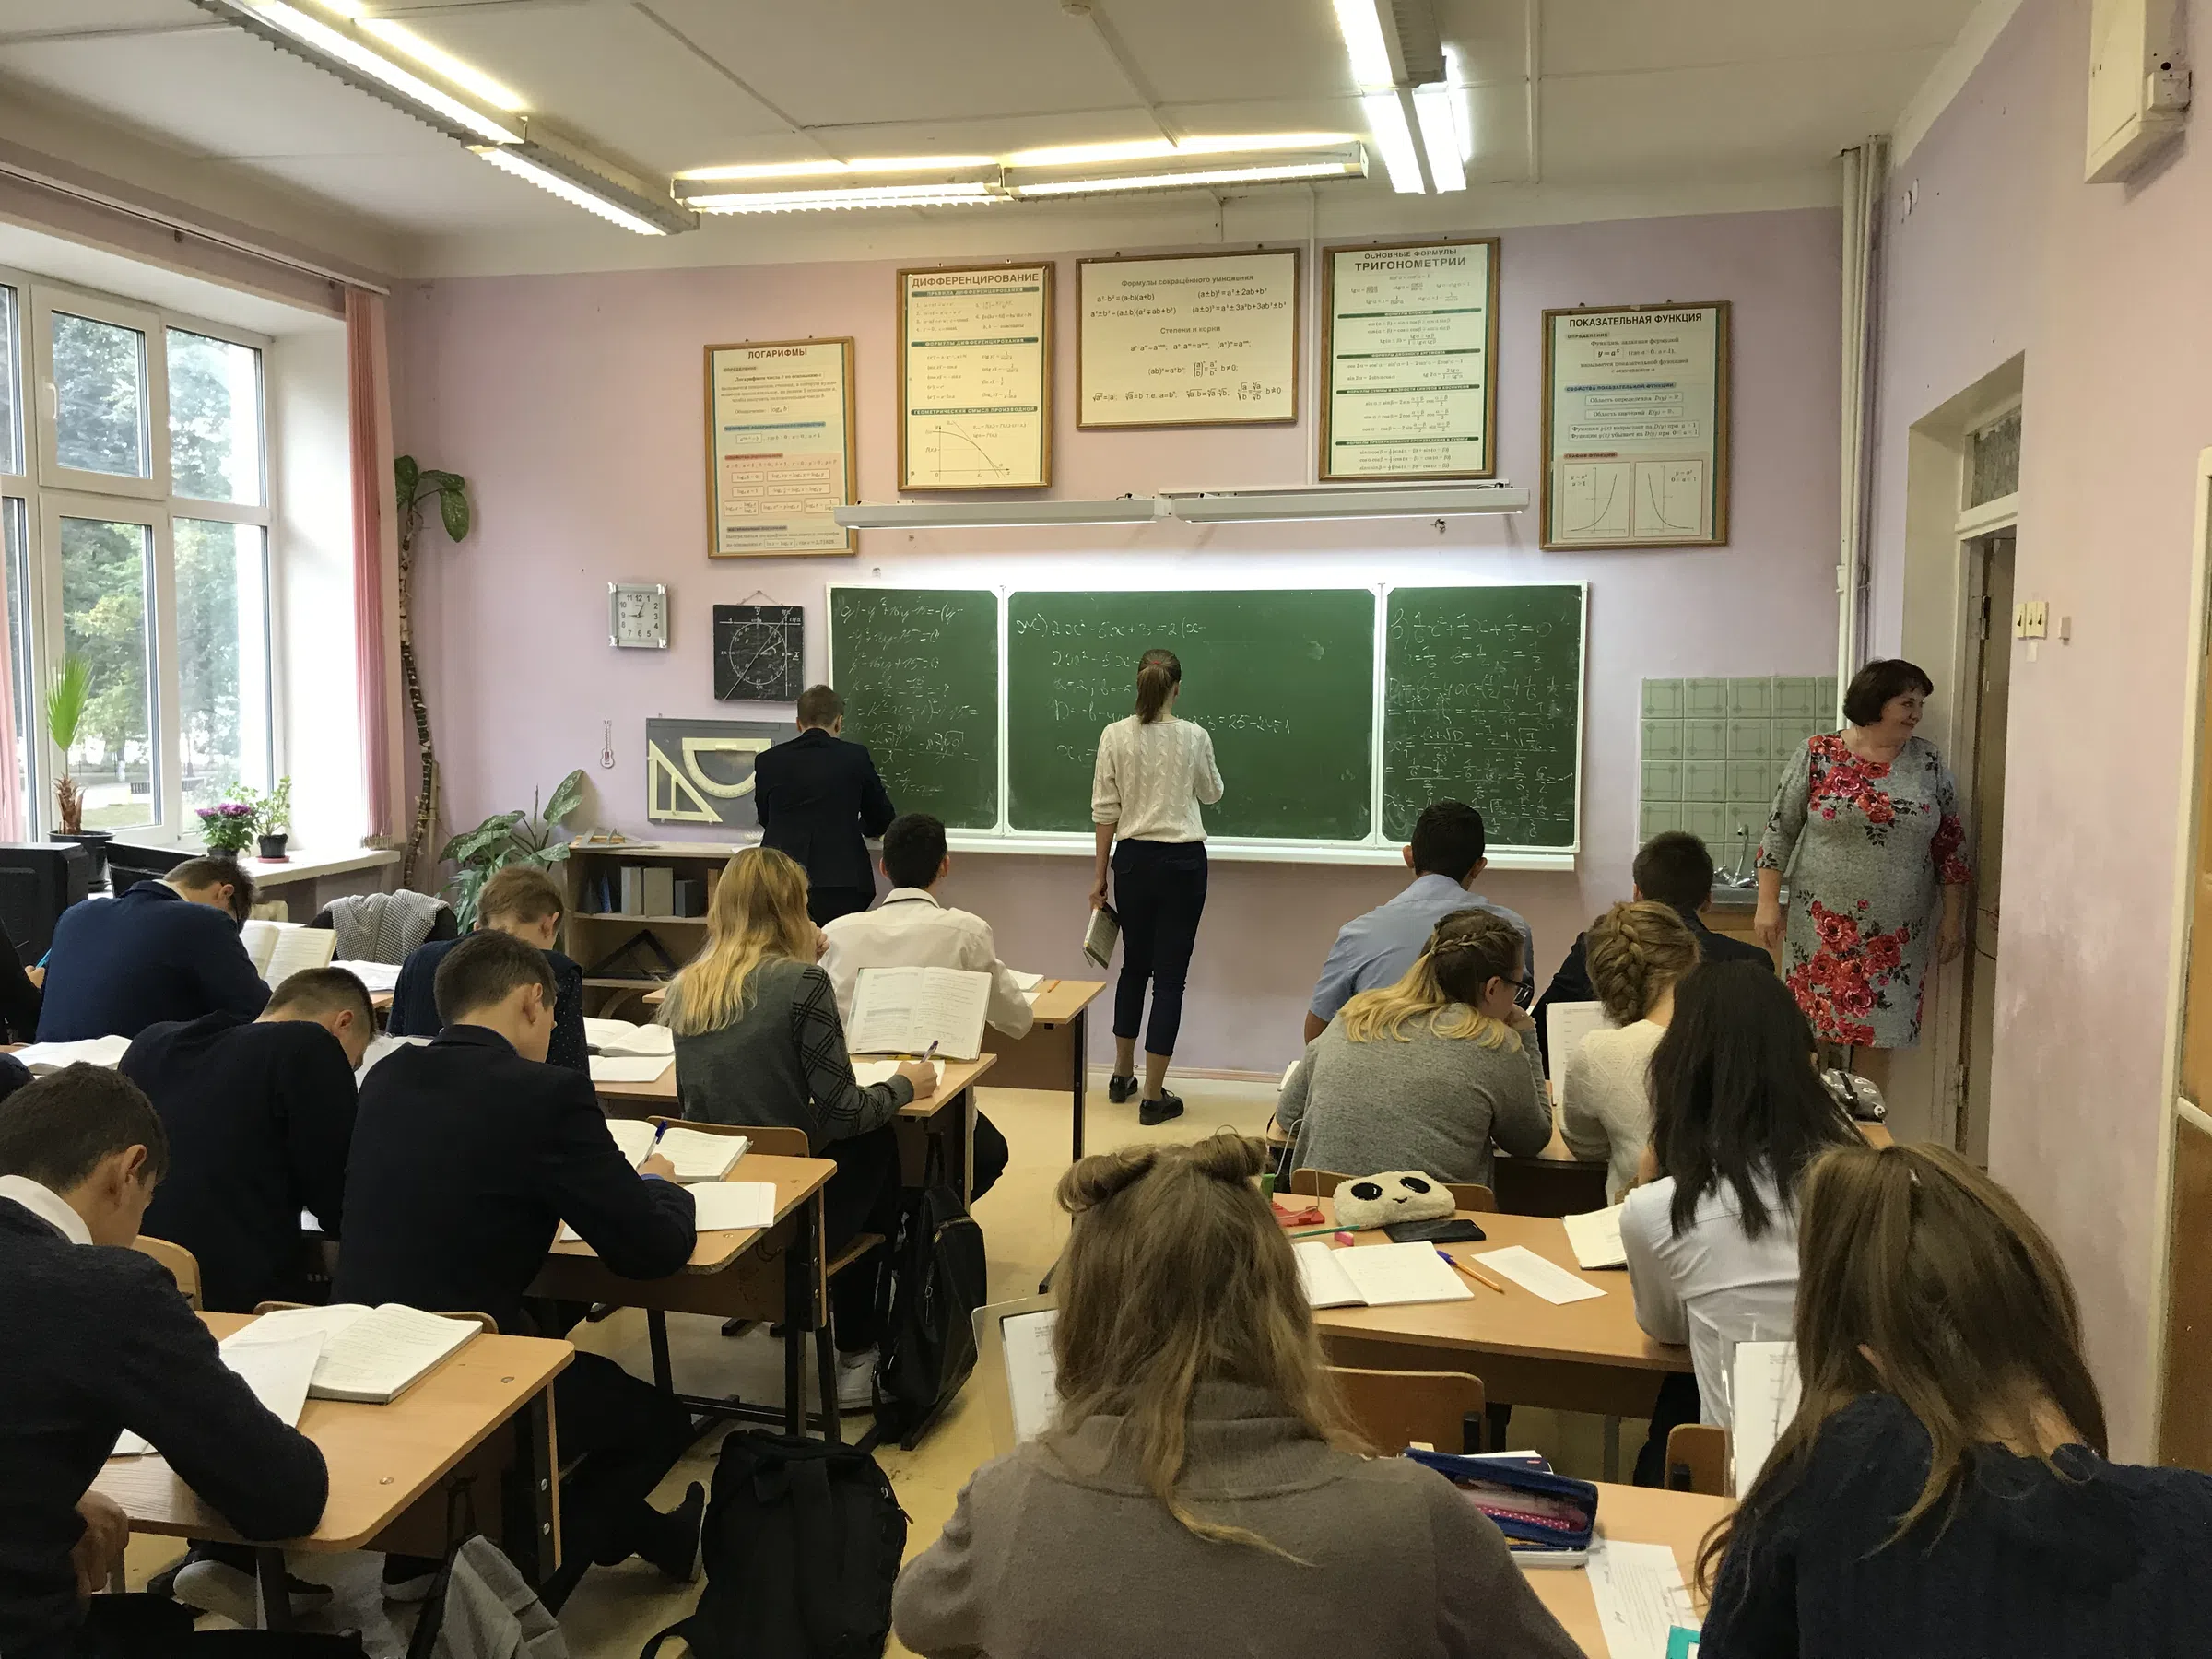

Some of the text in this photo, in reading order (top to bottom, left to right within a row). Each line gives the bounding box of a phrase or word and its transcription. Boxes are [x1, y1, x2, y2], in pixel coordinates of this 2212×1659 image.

[1364, 248, 1457, 260] ОСНОВНЫЕ ФОРМУЛЫ
[1354, 257, 1466, 271] ТРИГОНОМЕТРИИ
[912, 273, 1040, 288] ДИФФЕРЕНЦИРОВАНИЕ
[1569, 312, 1702, 327] ПОКАЗАТЕЛЬНАЯ ФУНКЦИЯ
[747, 348, 807, 359] ЛОГАРИФМЫ
